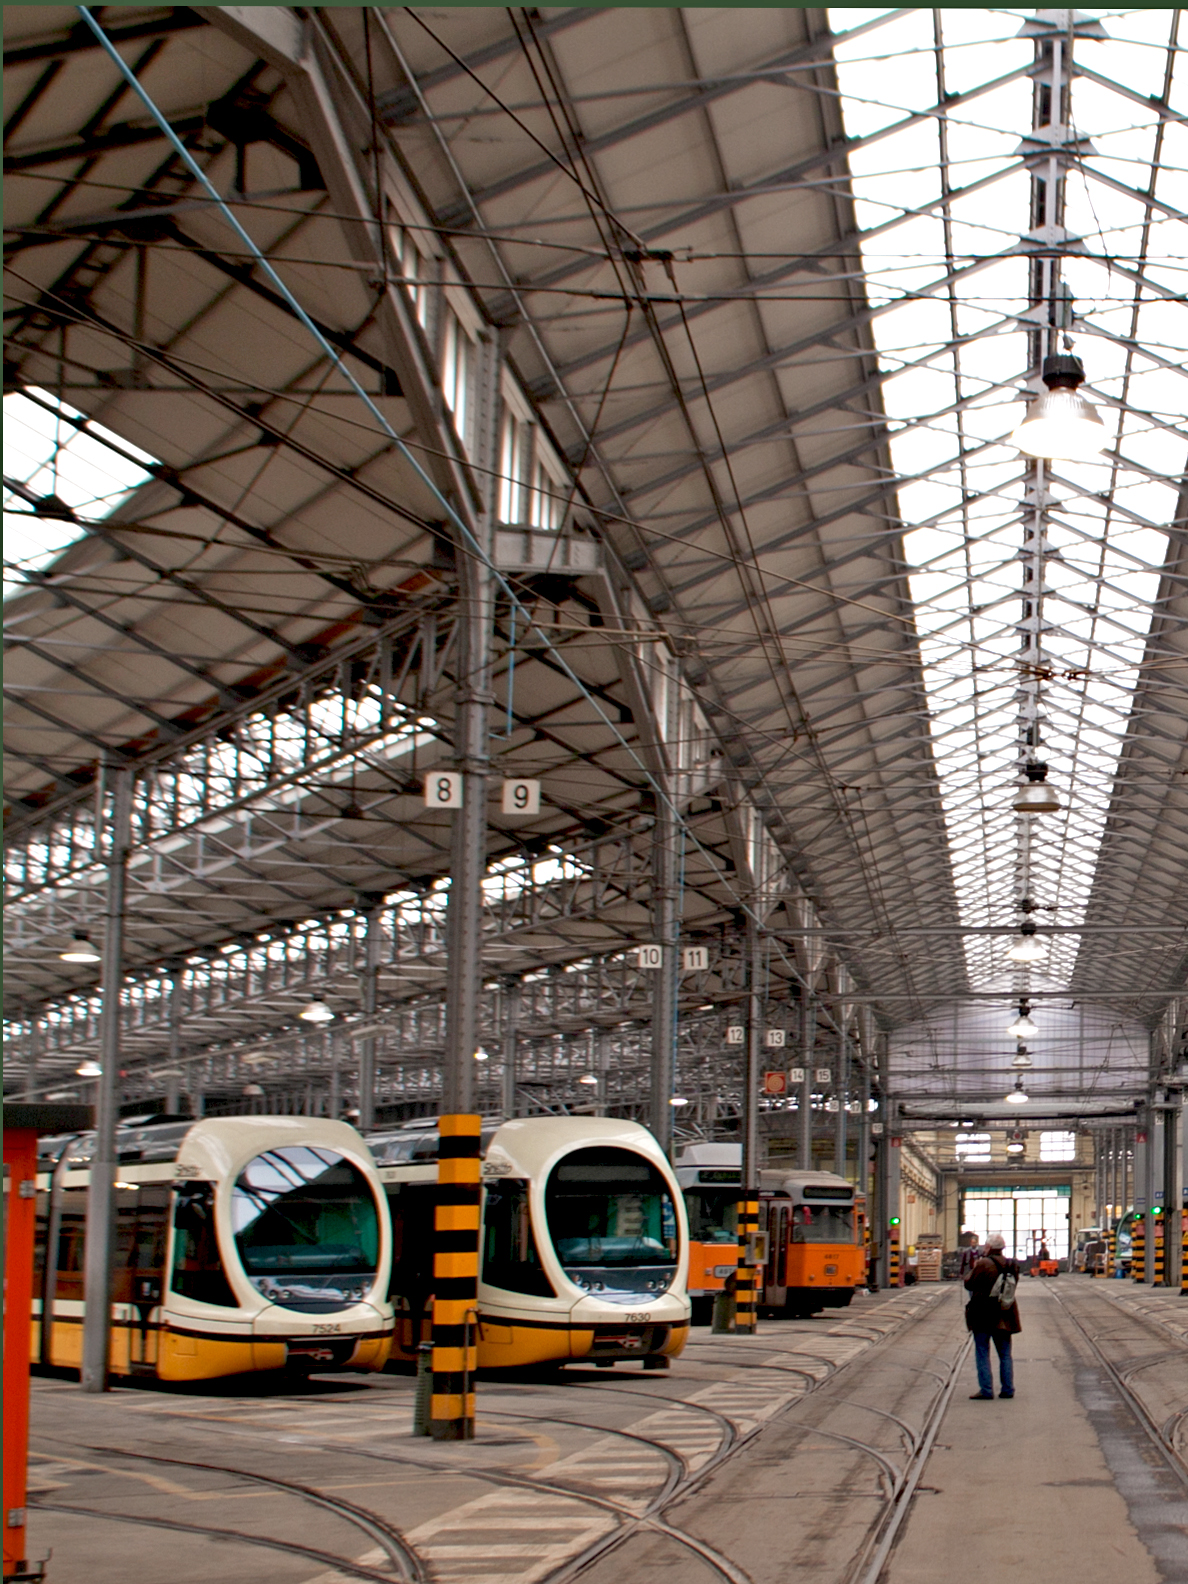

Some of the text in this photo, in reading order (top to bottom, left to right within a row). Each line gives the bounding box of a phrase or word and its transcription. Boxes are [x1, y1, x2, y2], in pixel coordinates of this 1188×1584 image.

[437, 778, 451, 802] 8
[514, 784, 529, 809] 9
[643, 948, 659, 965] 10
[688, 950, 702, 967] 11
[730, 1029, 743, 1042] 12
[769, 1031, 783, 1045] 13
[792, 1070, 803, 1080] 14
[818, 1070, 830, 1080] 15
[625, 1312, 651, 1323] 7630
[313, 1323, 341, 1334] 7524
